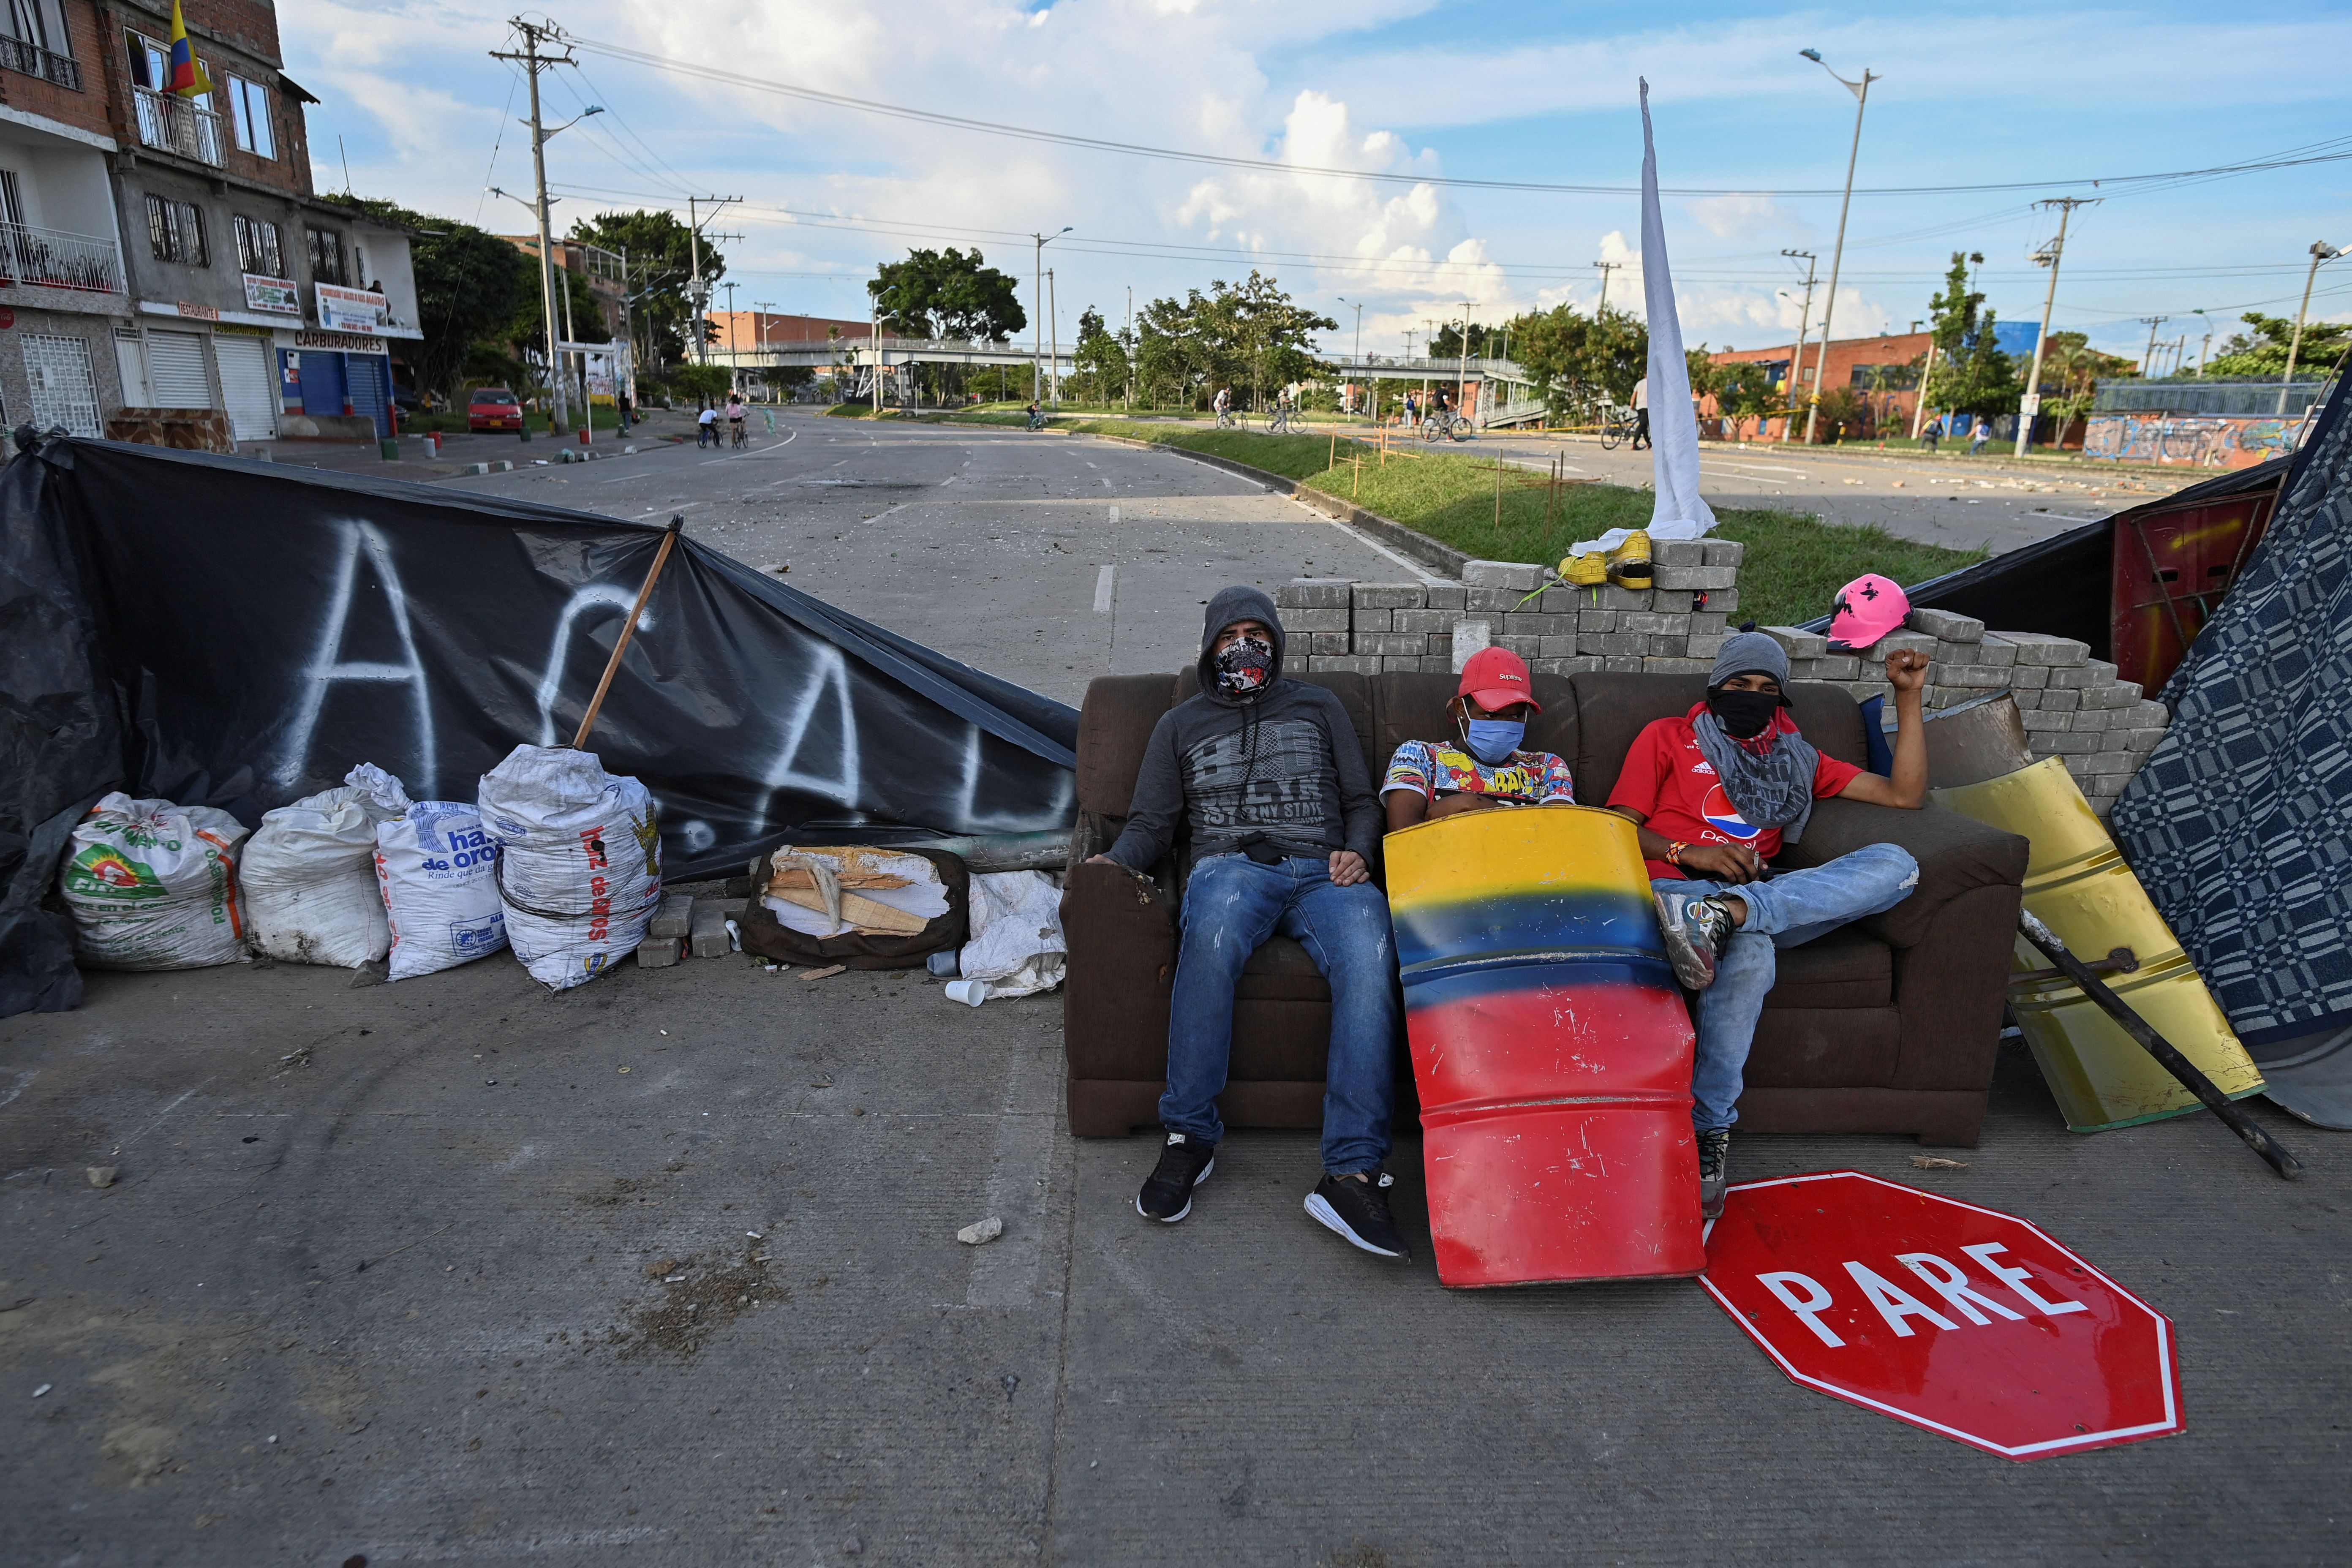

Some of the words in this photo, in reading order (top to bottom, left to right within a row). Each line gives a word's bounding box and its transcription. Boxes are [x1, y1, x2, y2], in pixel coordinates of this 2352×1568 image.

[366, 294, 385, 307] MAURO
[180, 303, 214, 319] RESTAURANTE
[295, 331, 382, 352] CARBURADORES
[1499, 673, 1524, 683] Supreme
[1691, 767, 1715, 775] adidas
[1259, 804, 1278, 818] NY
[1284, 802, 1325, 817] STATE
[447, 830, 494, 852] ha
[1700, 830, 1756, 850] pei
[422, 858, 449, 871] de
[428, 871, 455, 879] Rinde
[457, 869, 473, 878] que
[475, 865, 485, 873] da
[1755, 1242, 2088, 1348] PARE
